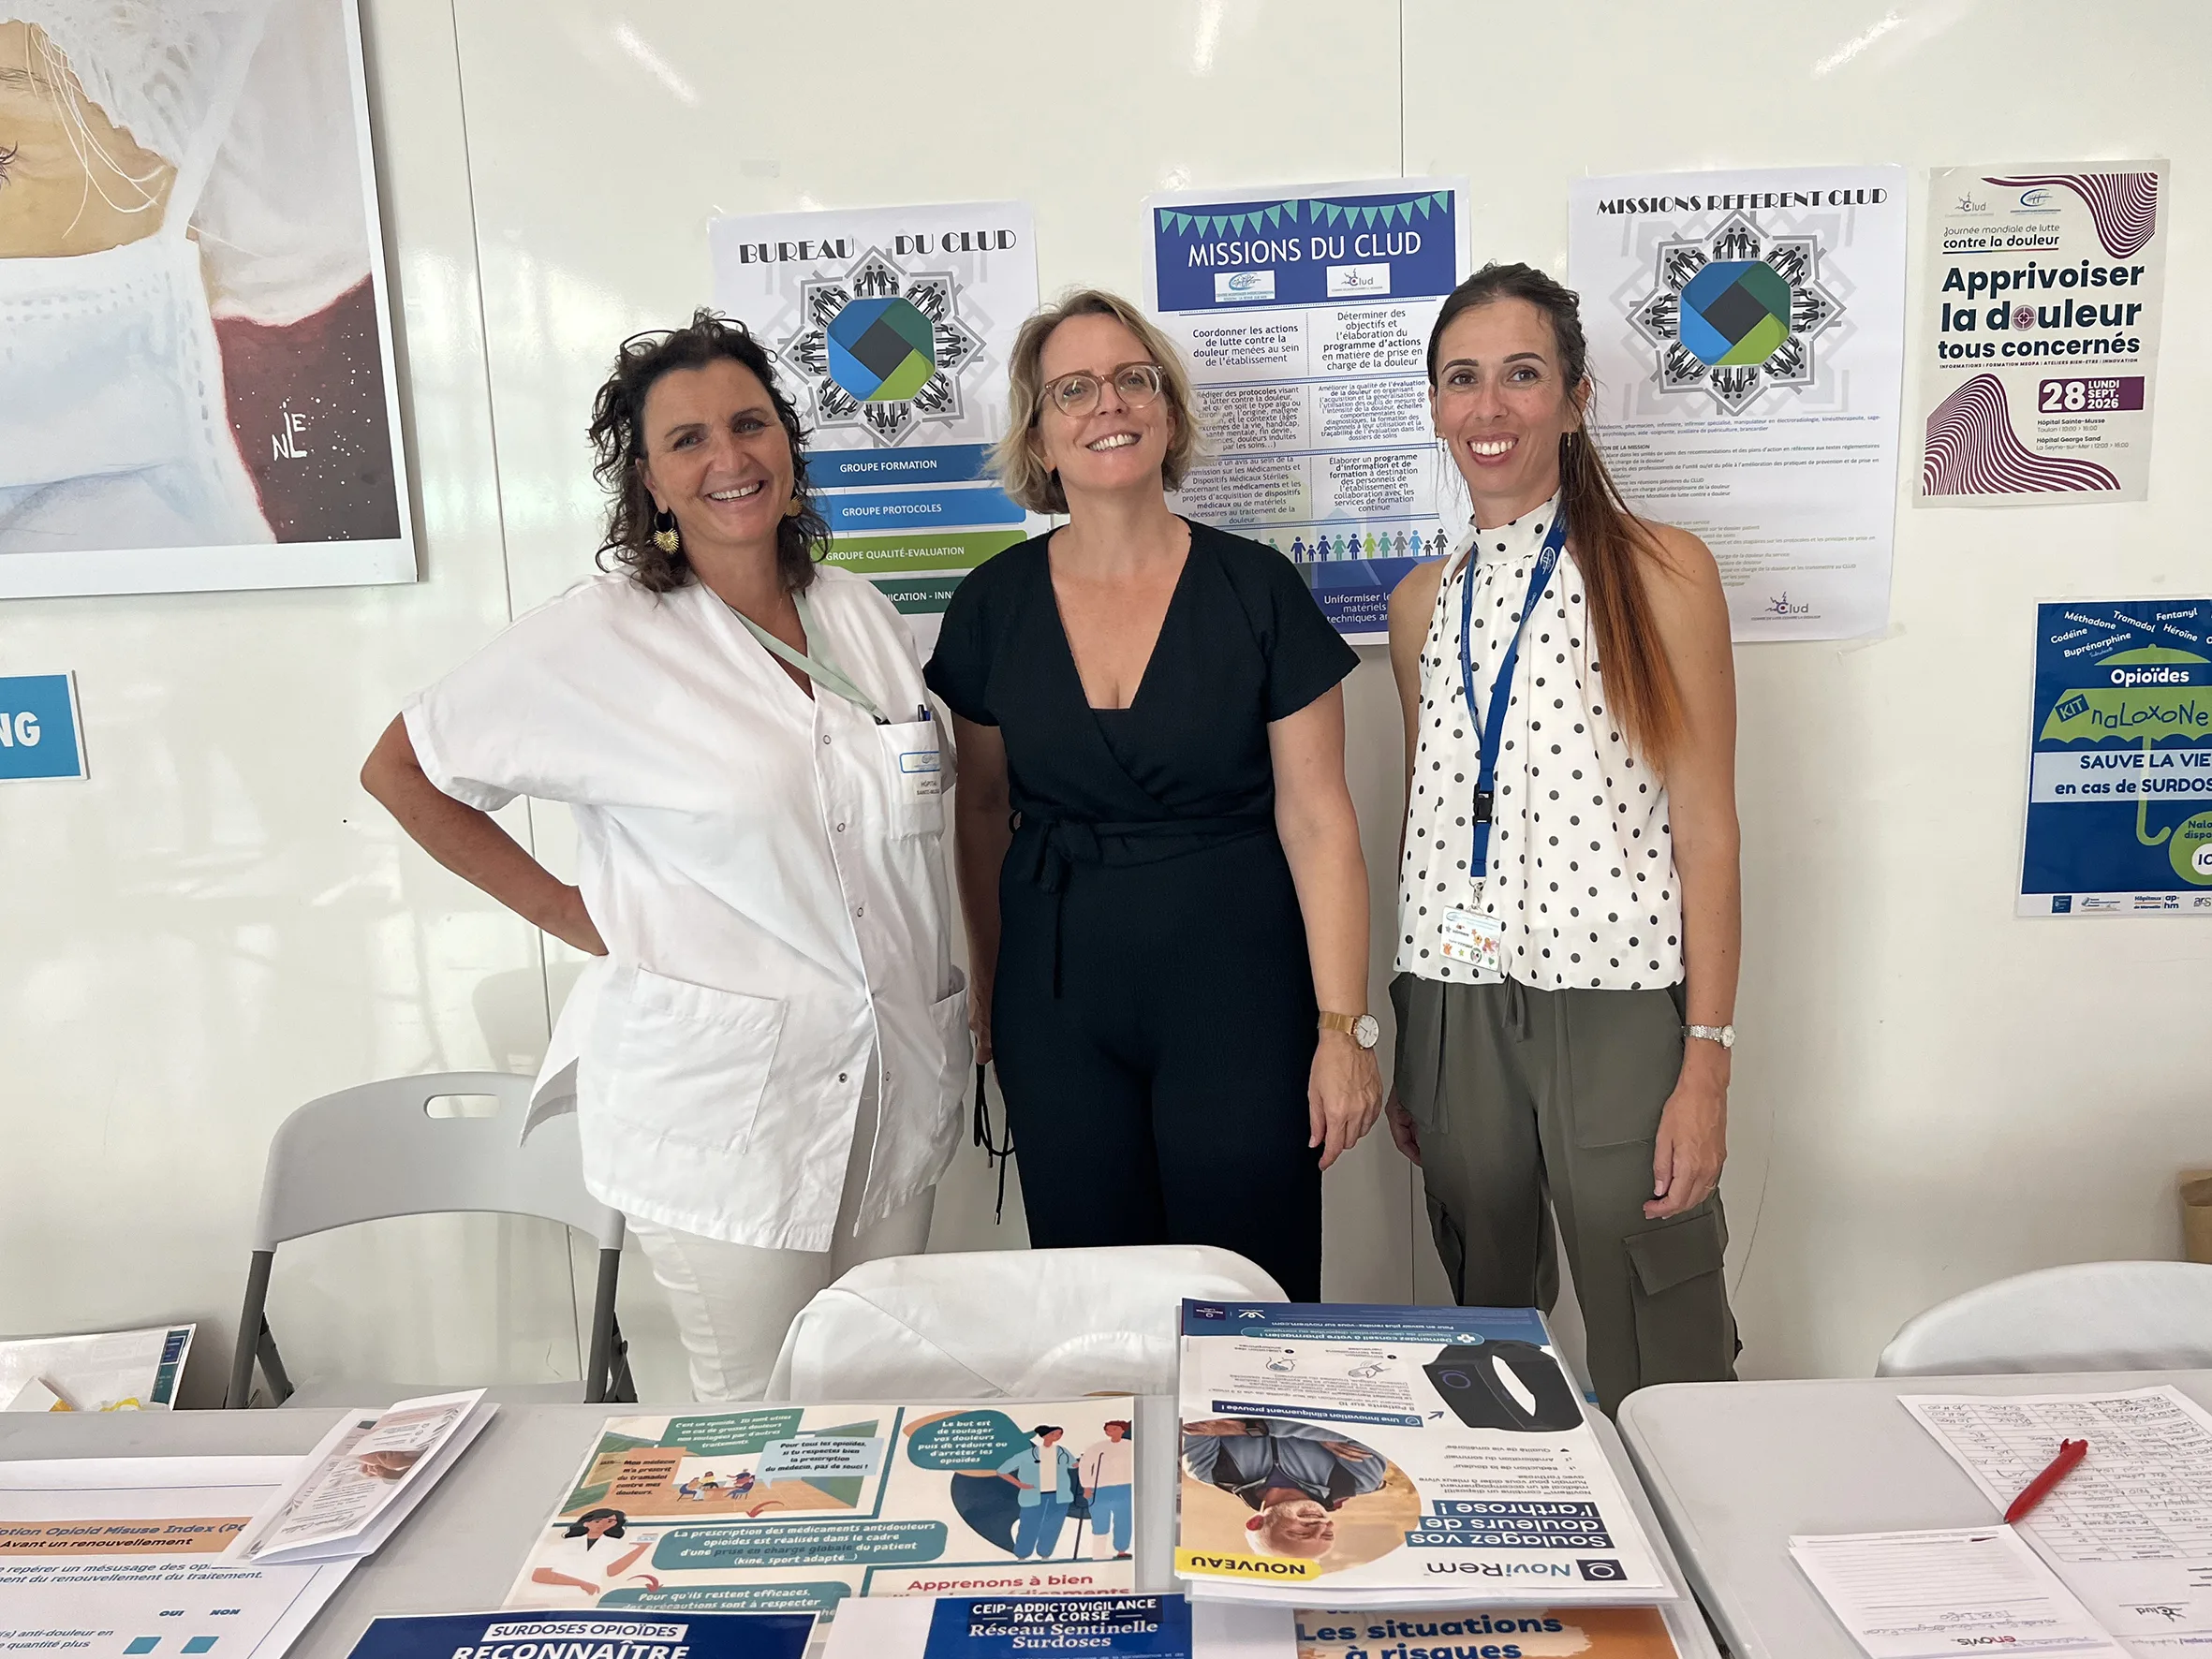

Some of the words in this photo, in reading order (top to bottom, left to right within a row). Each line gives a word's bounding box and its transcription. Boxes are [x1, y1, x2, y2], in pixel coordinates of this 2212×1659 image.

[1597, 195, 1702, 215] MISSIONS
[1708, 190, 1823, 211] REFERENT
[1828, 188, 1888, 205] CLUD
[1982, 226, 2023, 236] mondiale
[2026, 225, 2037, 235] de
[739, 239, 854, 264] BUREAU
[895, 234, 935, 256] DU
[941, 230, 1017, 253] CLUD
[1943, 238, 1985, 248] contre
[1991, 236, 2002, 246] la
[2007, 234, 2059, 246] douleur
[1188, 239, 1301, 267] MISSIONS
[1311, 236, 1344, 259] DU
[1355, 231, 1421, 257] CLUD
[1942, 259, 2145, 301] Apprivoiser
[1941, 302, 1977, 332] la
[1265, 325, 1298, 335] actions
[1346, 320, 1385, 331] objectifs
[1324, 341, 1376, 352] programme
[1939, 341, 1996, 360] tous
[2002, 331, 2140, 357] concernés
[1388, 349, 1408, 360] prise
[1327, 360, 1357, 371] charge
[2042, 381, 2086, 411] 28
[2087, 389, 2119, 399] SEPT.
[2087, 399, 2119, 409] 2026
[883, 504, 941, 514] PROTOCOLES
[826, 551, 863, 561] GROUPE
[1326, 614, 1377, 624] techniques
[2064, 611, 2116, 630] Méthadone
[2113, 610, 2156, 633] Tramadol
[2156, 608, 2198, 622] Fentanyl
[2051, 627, 2087, 644] Codéine
[2163, 624, 2198, 641] Héroïne
[2064, 632, 2131, 658] Buprénorphine
[2111, 668, 2190, 687] Opioïdes
[2059, 698, 2083, 719] KIT
[2080, 754, 2145, 770] SAUVE
[2149, 754, 2174, 768] LA
[2180, 753, 2211, 767] VIE
[2055, 784, 2076, 795] en
[2081, 783, 2110, 794] cas
[2116, 779, 2136, 793] de
[1226, 1403, 1264, 1415] prouvée
[1266, 1406, 1328, 1419] cliniquement
[1330, 1413, 1379, 1423] innovation
[691, 1526, 762, 1539] prescription
[765, 1525, 785, 1535] des
[788, 1523, 860, 1534] médicaments
[863, 1521, 936, 1532] antidouleurs
[1424, 1518, 1463, 1532] de
[1469, 1518, 1600, 1533] douleurs
[1409, 1534, 1463, 1546] vos
[1468, 1532, 1607, 1548] Soulagez
[1191, 1556, 1305, 1575] NOUVEAU
[907, 1578, 1023, 1592] Apprenons
[1048, 1575, 1093, 1585] bien
[972, 1599, 1157, 1615] CEIP-ADDICTOVIGILANCE
[1058, 1611, 1111, 1622] CORSE
[492, 1624, 588, 1637] SURDOSES
[591, 1622, 678, 1637] OPIOÏDES
[969, 1622, 1044, 1637] Réseau
[1051, 1621, 1158, 1636] Sentinelle
[1297, 1623, 1357, 1640] Les
[1367, 1614, 1564, 1638] situations
[7, 1640, 60, 1651] quantité
[1012, 1635, 1111, 1648] Surdoses
